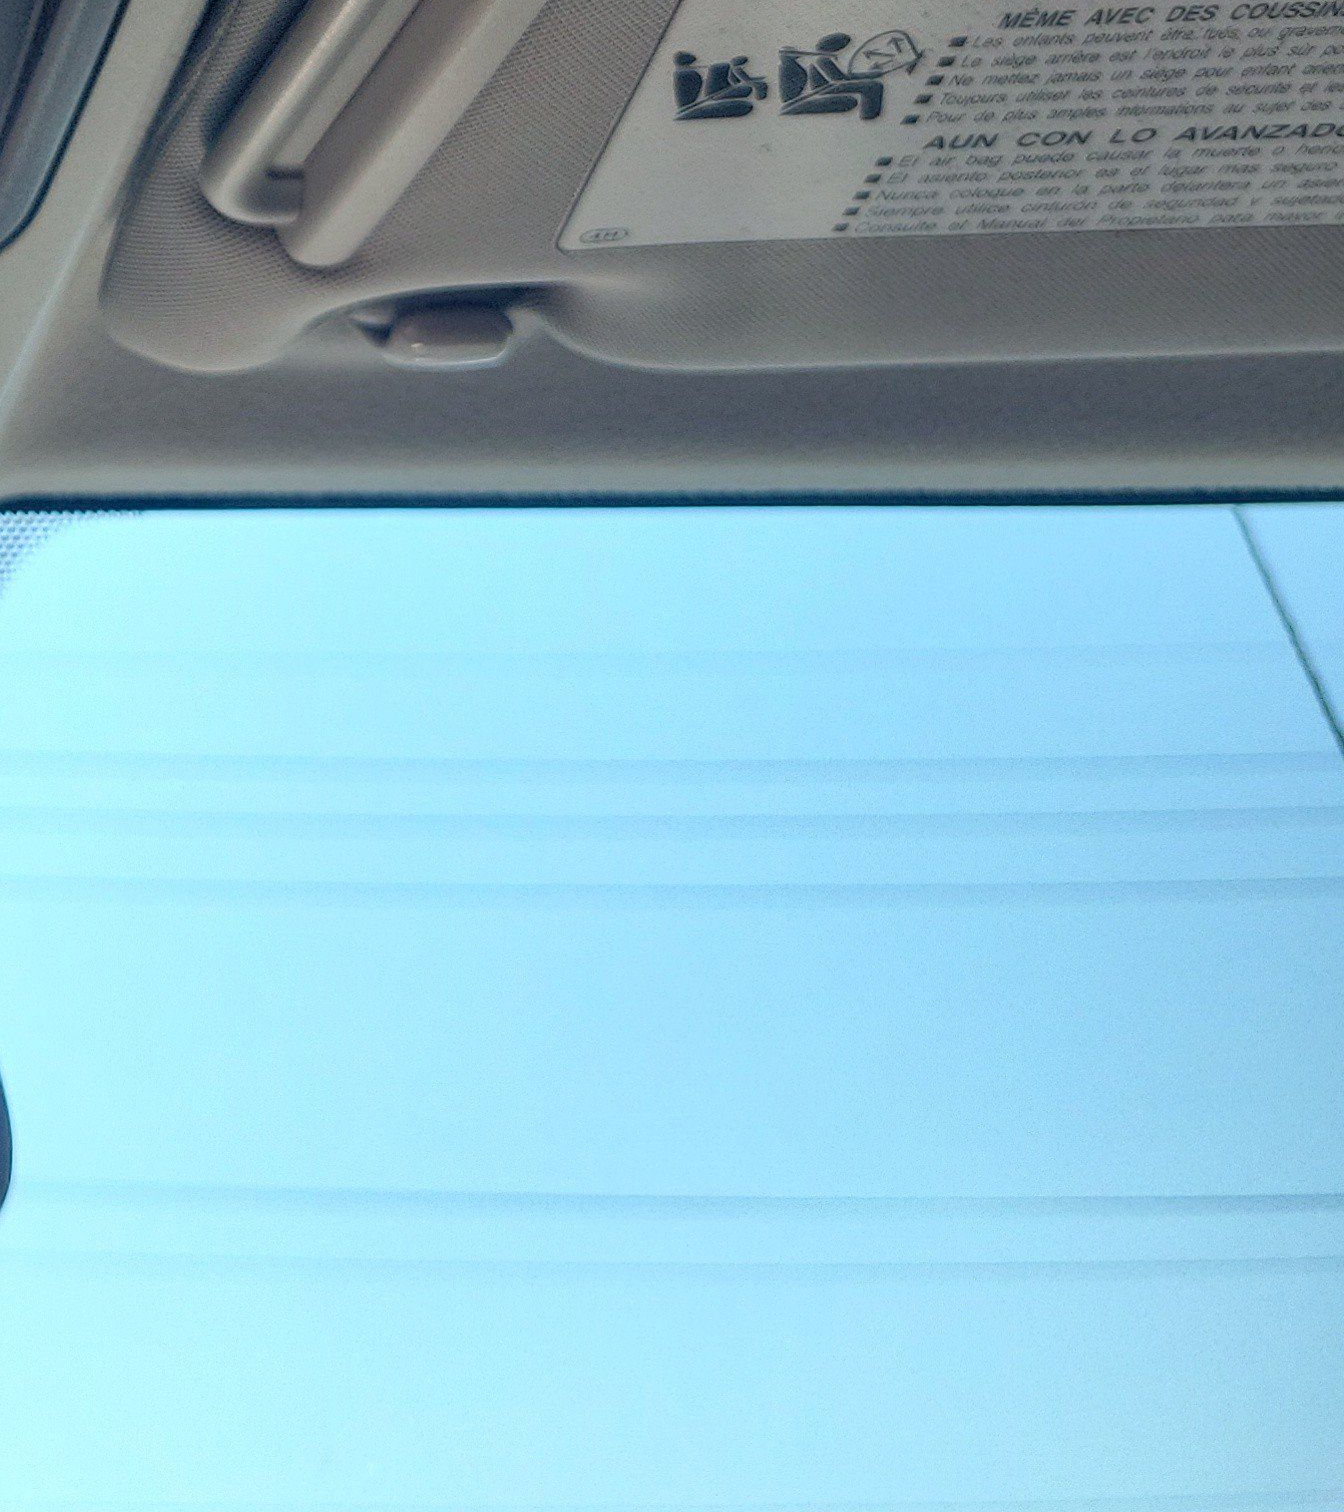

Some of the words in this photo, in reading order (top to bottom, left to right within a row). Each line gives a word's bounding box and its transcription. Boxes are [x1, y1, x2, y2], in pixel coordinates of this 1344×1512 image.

[1083, 6, 1155, 26] AVEC
[1165, 4, 1220, 23] DES
[921, 132, 1000, 150] AUN
[1015, 129, 1093, 148] CON
[1109, 127, 1158, 144] LO
